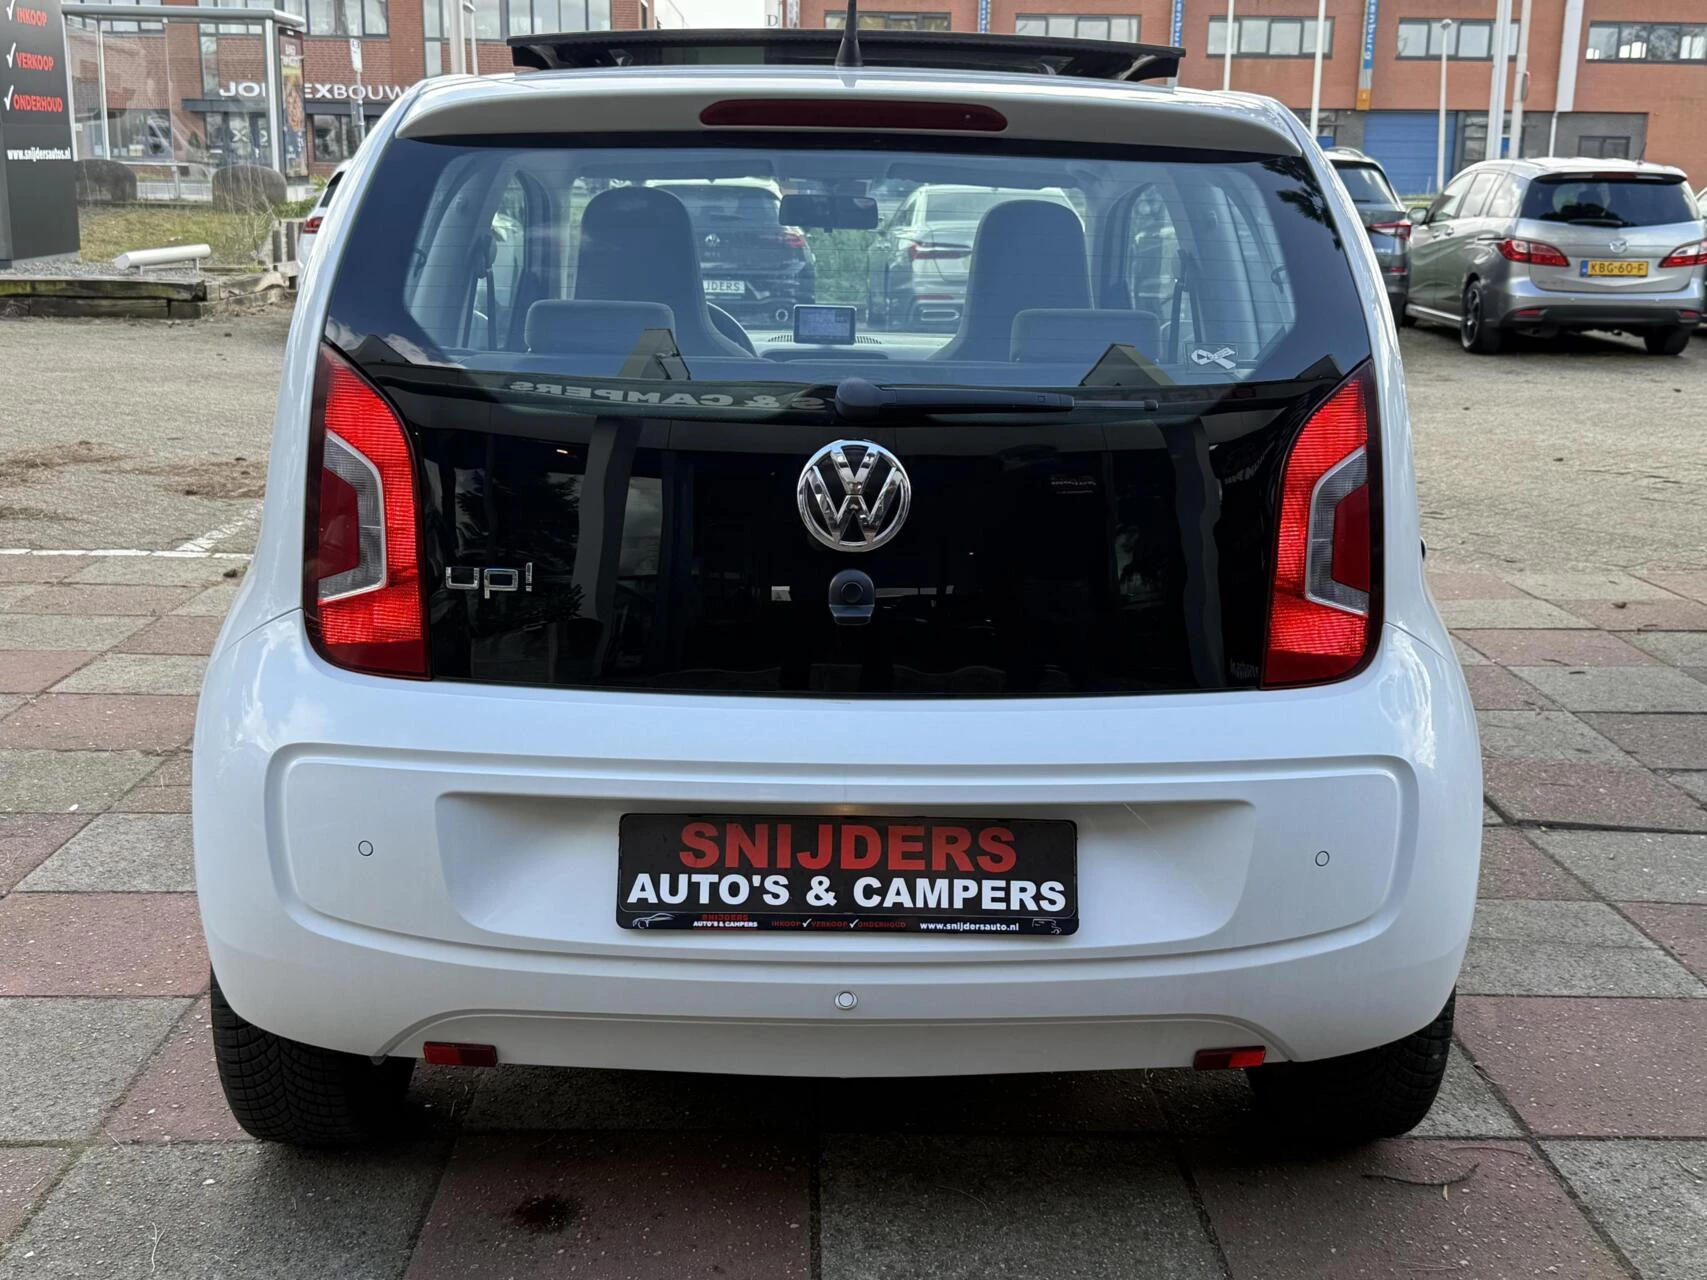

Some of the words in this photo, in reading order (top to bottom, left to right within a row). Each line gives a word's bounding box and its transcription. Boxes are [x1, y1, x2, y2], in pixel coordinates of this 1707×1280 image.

[16, 7, 48, 27] INKOOP
[16, 51, 54, 71] VERKOOP
[13, 94, 63, 112] ONDERHOUD
[1590, 263, 1645, 274] KBG-60-F
[445, 562, 533, 600] up!
[679, 821, 1017, 873] SNIJDERS
[627, 873, 790, 906] AUTO'S
[806, 875, 838, 906] &
[853, 876, 1066, 912] CAMPERS
[857, 921, 906, 929] ONDERHOUD
[919, 922, 1020, 932] www.snijdersauto.nl
